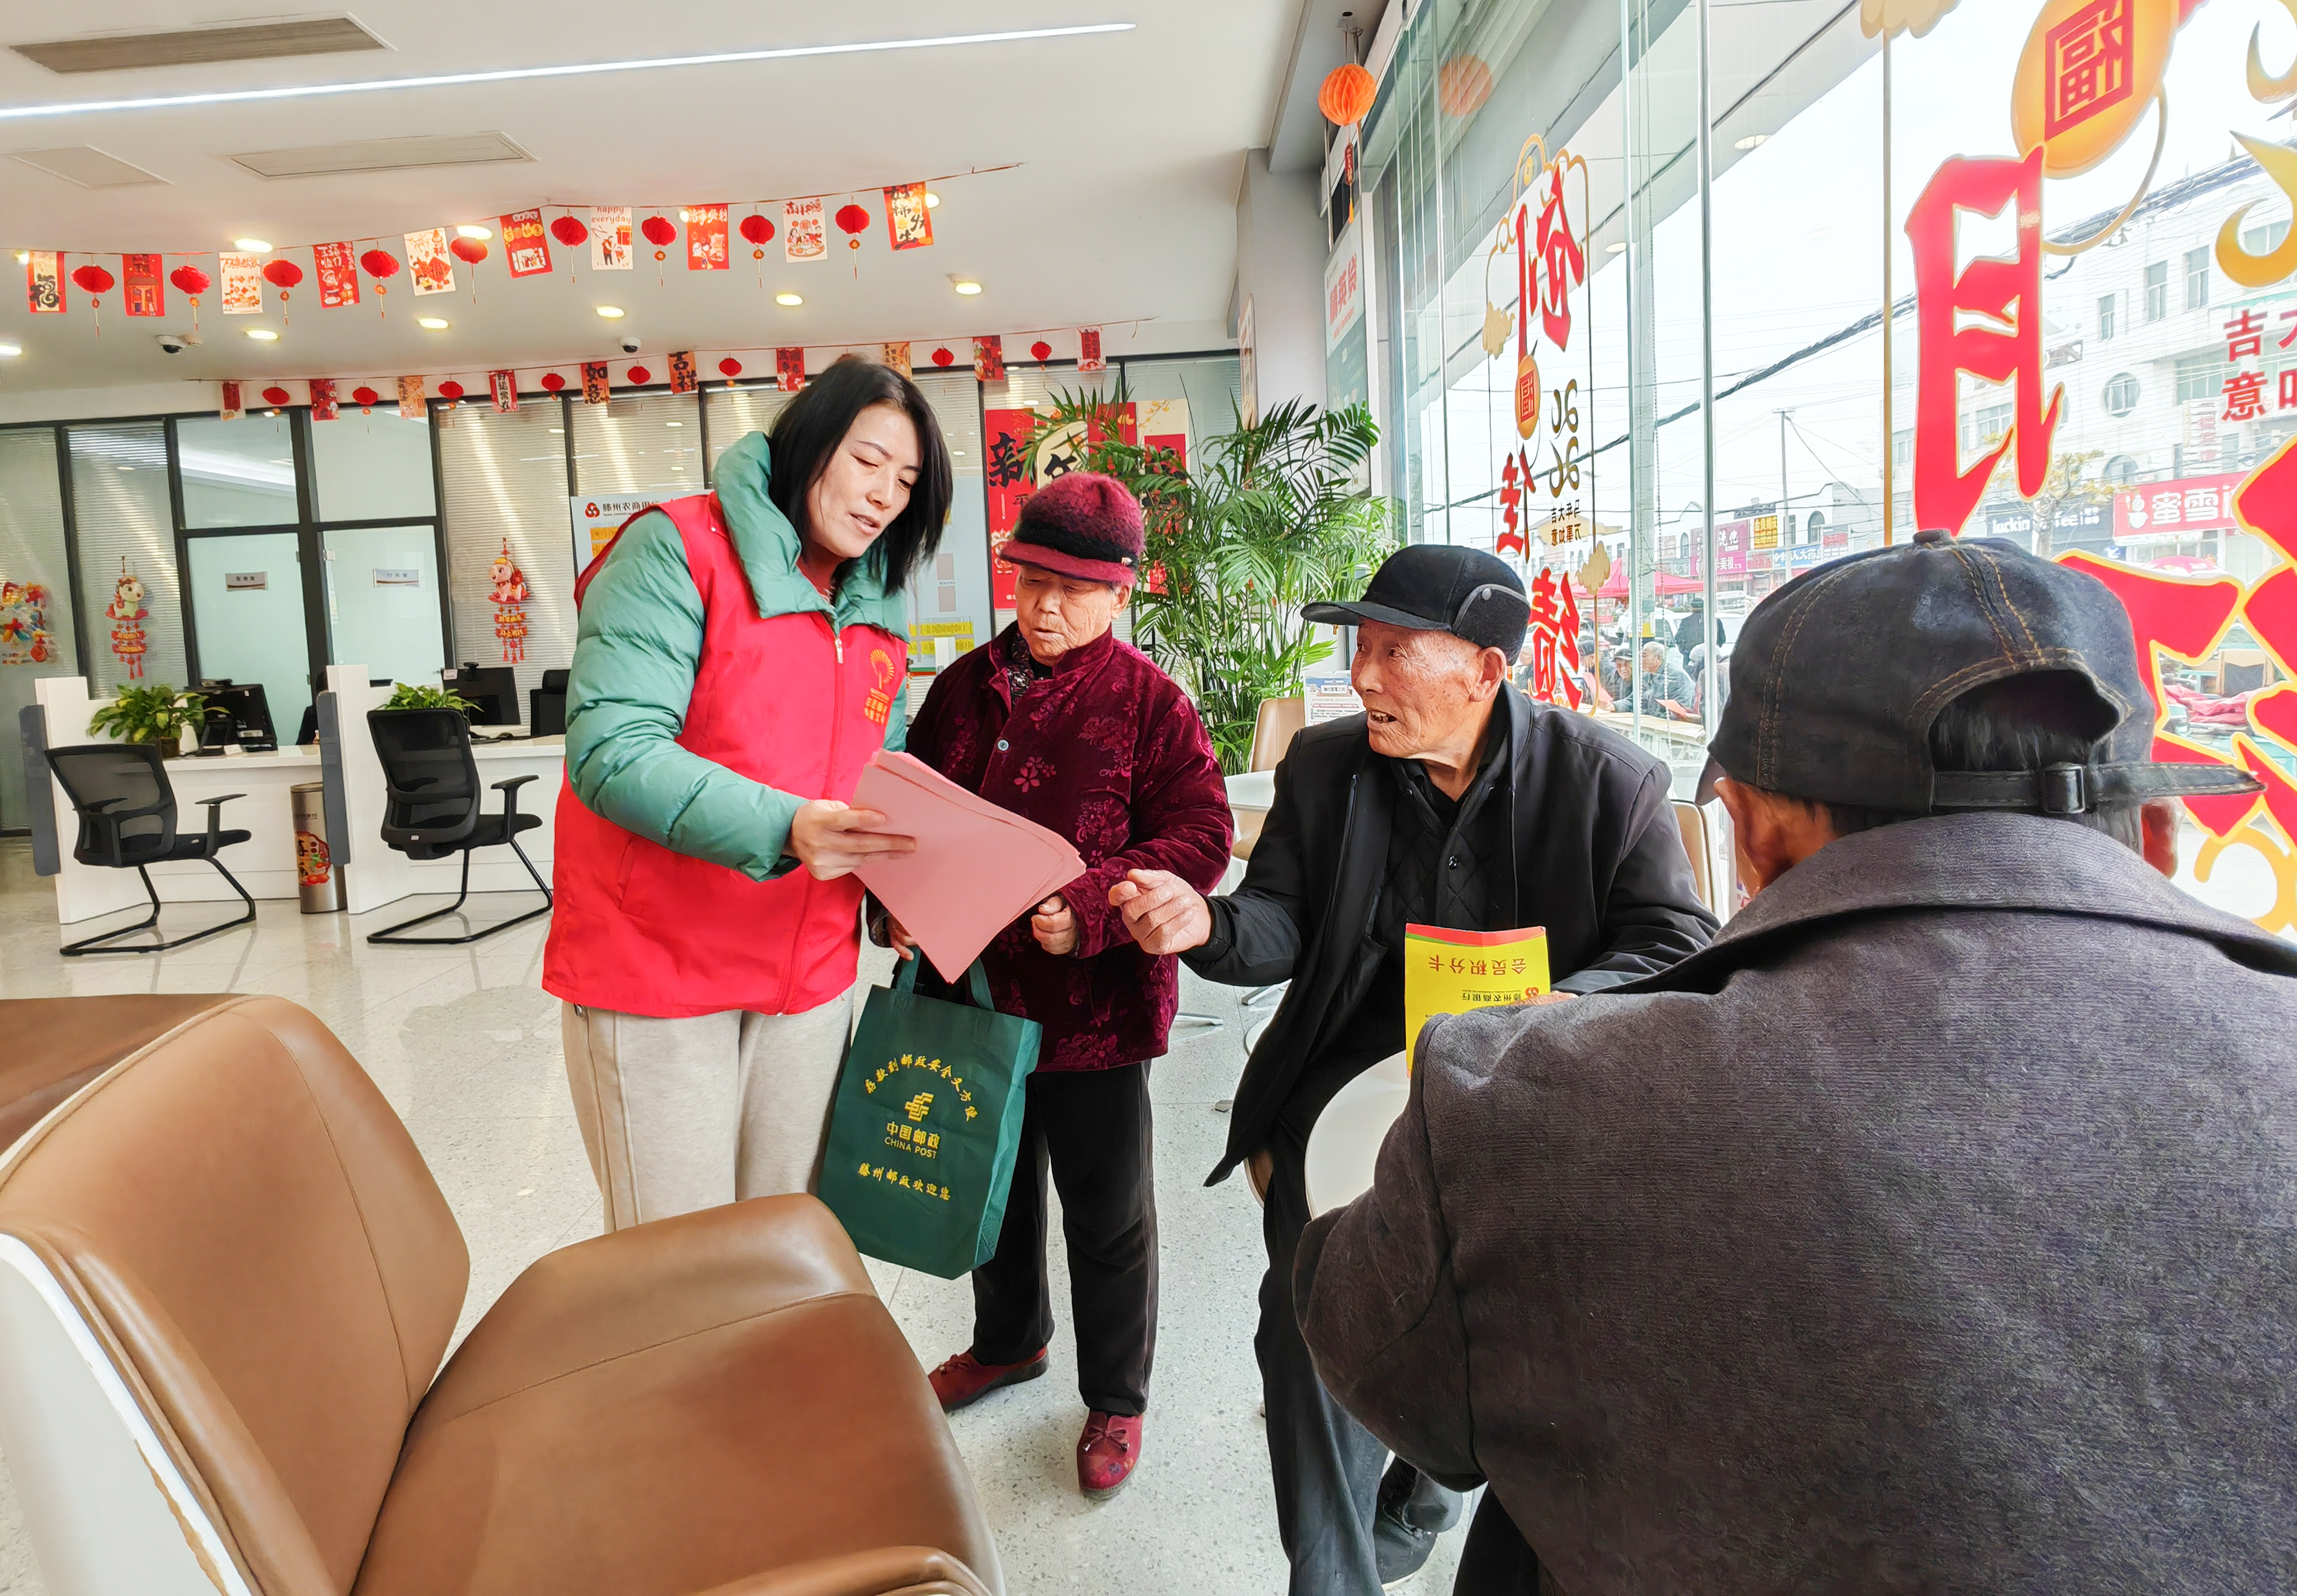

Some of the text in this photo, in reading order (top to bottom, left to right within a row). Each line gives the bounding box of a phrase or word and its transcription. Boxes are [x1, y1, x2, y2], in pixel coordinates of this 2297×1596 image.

[591, 216, 631, 224] everyday
[585, 363, 611, 404] 如意
[670, 351, 699, 391] 吉祥
[1992, 513, 2030, 535] luckin
[1428, 954, 1527, 976] 会员积分卡
[886, 1121, 941, 1149] 中国邮政
[884, 1137, 937, 1160] CHINA POST
[858, 1162, 951, 1201] 滕州邮政欢迎您
